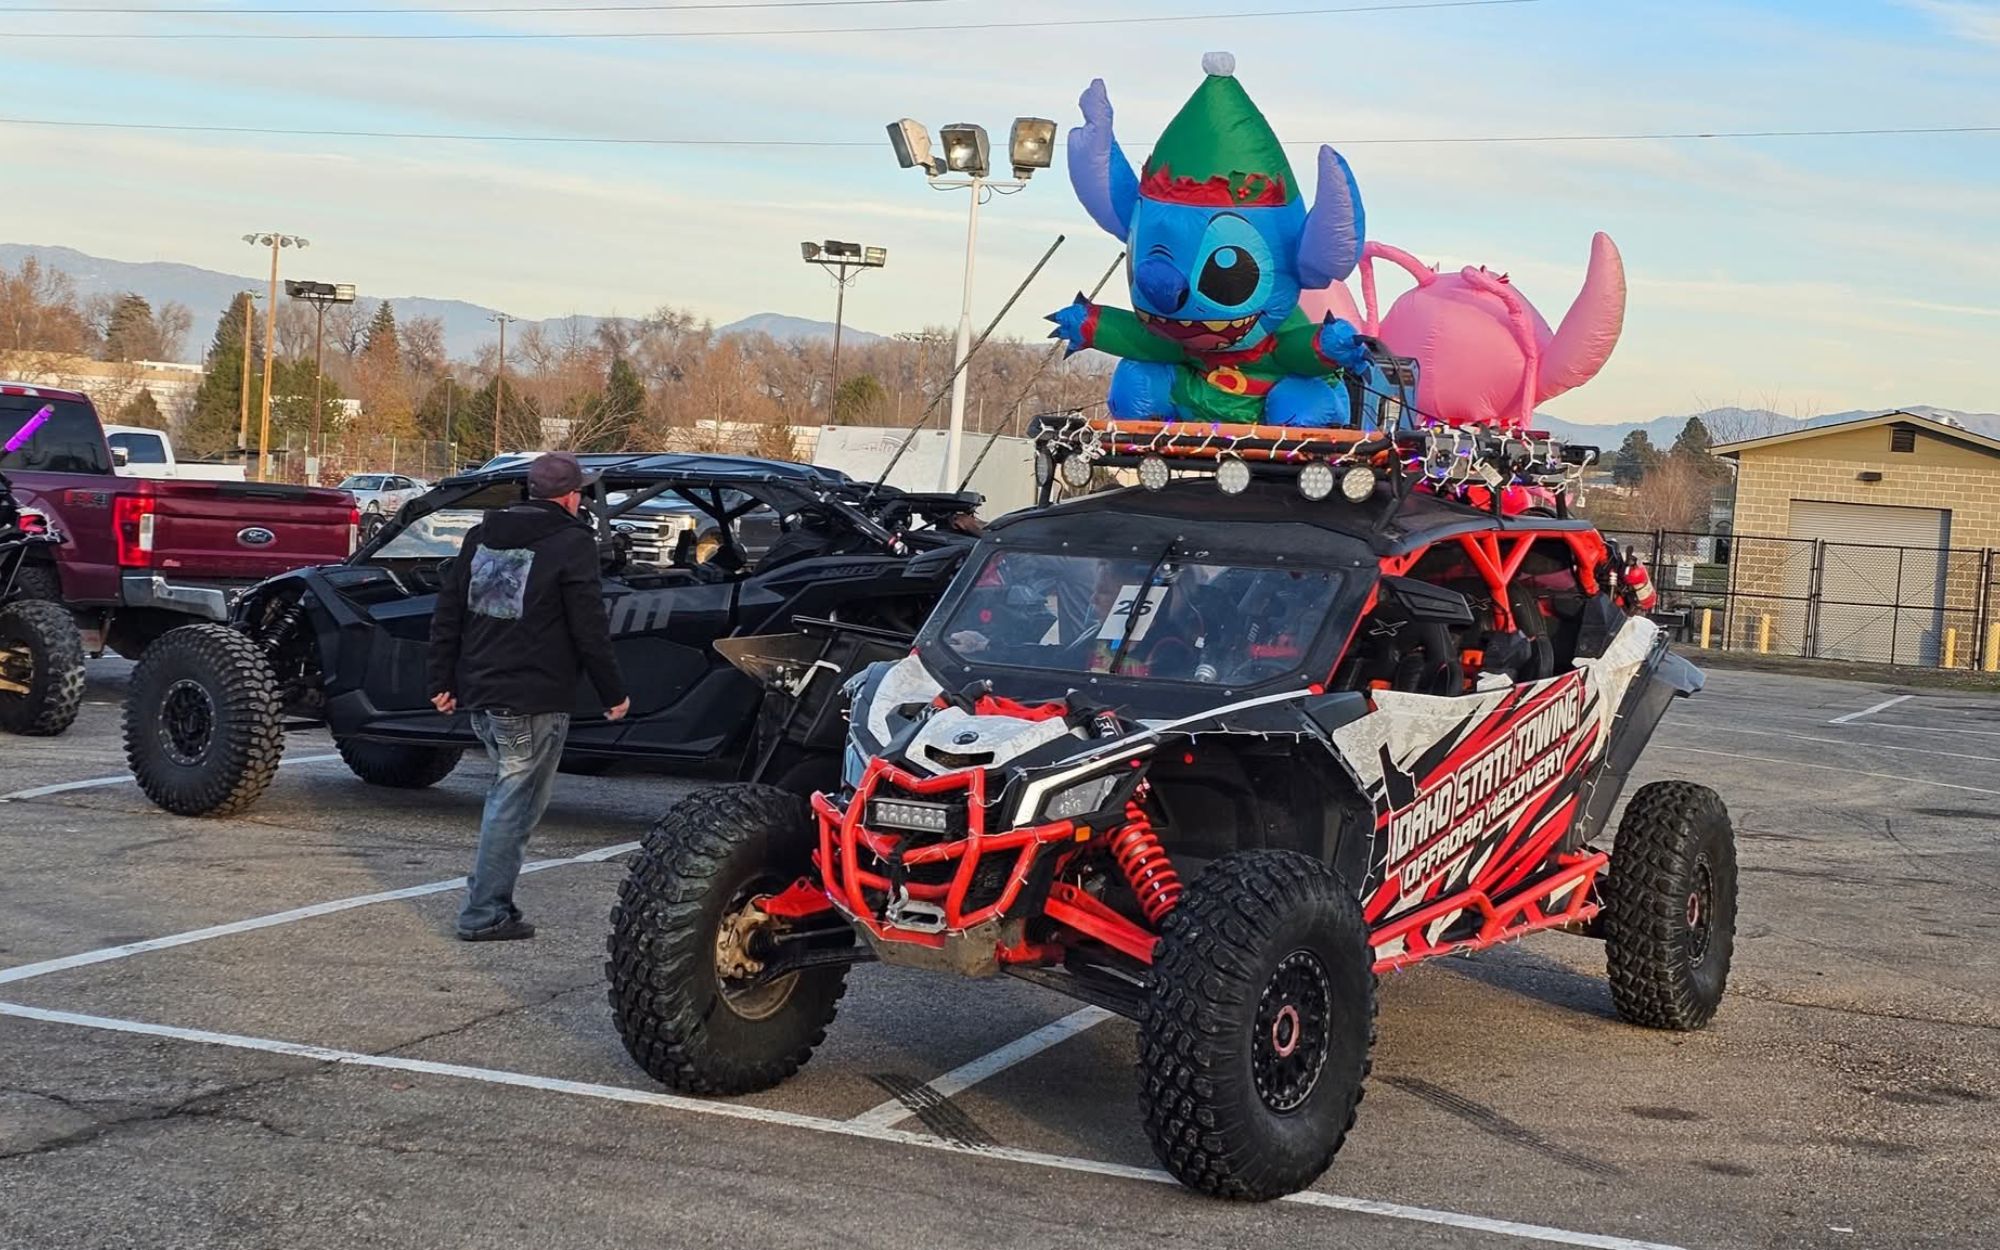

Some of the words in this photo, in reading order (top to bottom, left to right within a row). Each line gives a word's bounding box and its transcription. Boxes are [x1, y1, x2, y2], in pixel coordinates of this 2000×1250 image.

[1113, 600, 1153, 616] 26
[1390, 782, 1453, 865] IDAHO
[1454, 737, 1513, 817] STATE
[1517, 686, 1578, 768] TOWING
[1403, 809, 1485, 890] OFFROAD
[1485, 742, 1567, 825] RECOVERY
